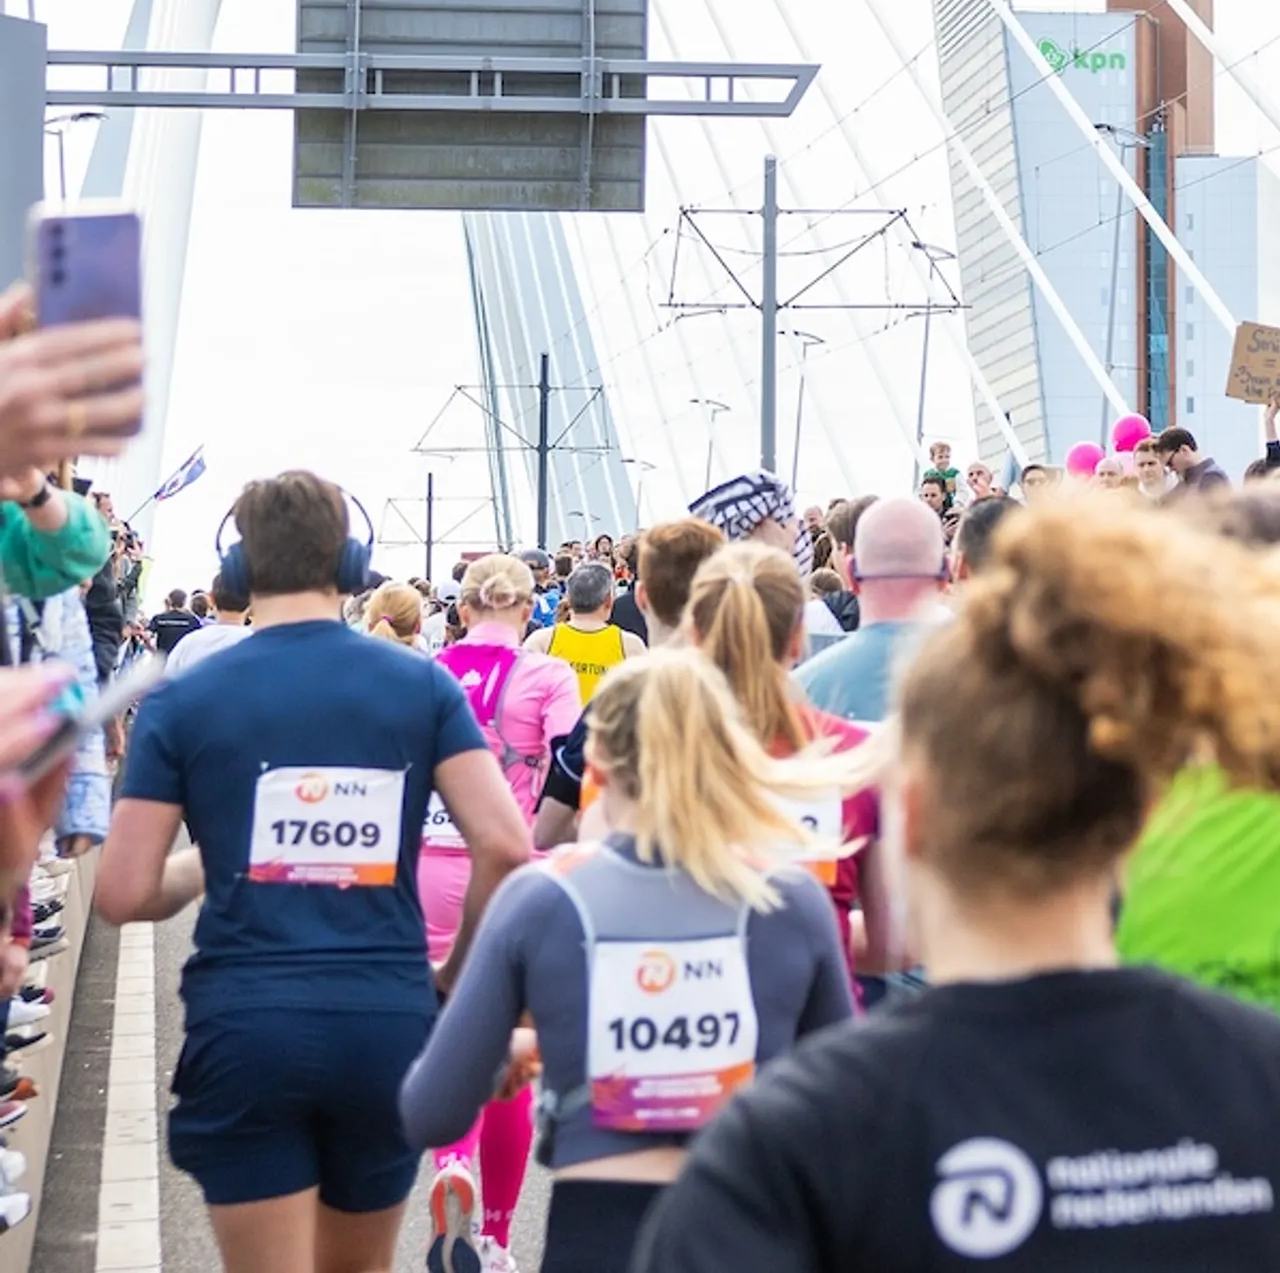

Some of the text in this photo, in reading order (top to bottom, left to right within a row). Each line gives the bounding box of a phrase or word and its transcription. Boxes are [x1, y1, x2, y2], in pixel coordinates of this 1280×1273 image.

[1074, 48, 1126, 74] kpn
[334, 783, 367, 797] NN
[271, 819, 381, 848] 17609
[683, 959, 724, 981] NN
[608, 1011, 741, 1052] 10497
